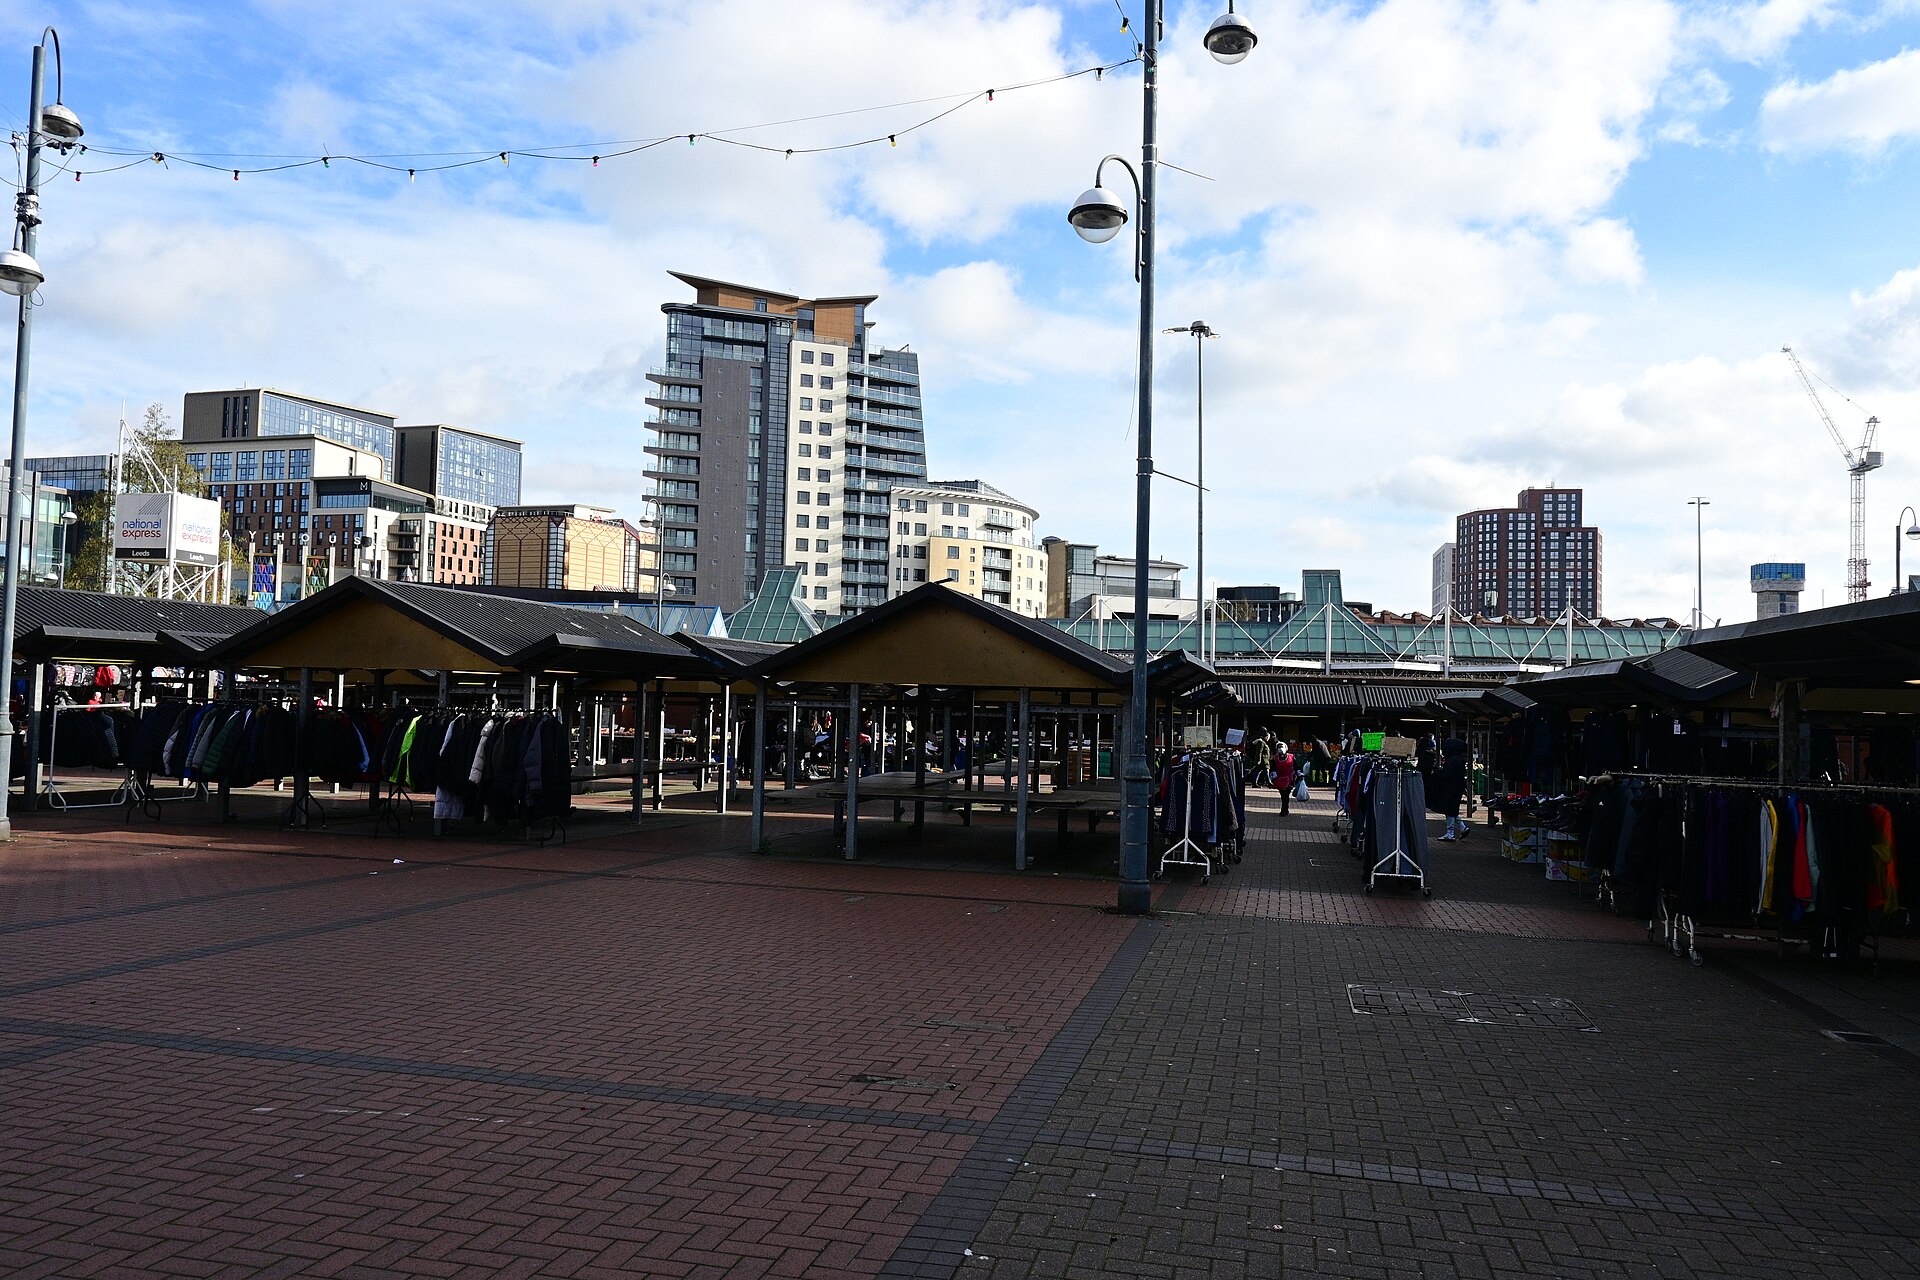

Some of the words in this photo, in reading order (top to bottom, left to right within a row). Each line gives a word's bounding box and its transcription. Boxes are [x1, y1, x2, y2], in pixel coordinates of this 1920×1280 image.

[122, 518, 162, 529] national
[182, 522, 213, 535] national
[122, 529, 162, 540] express
[181, 532, 213, 545] express
[189, 553, 204, 562] Leeds
